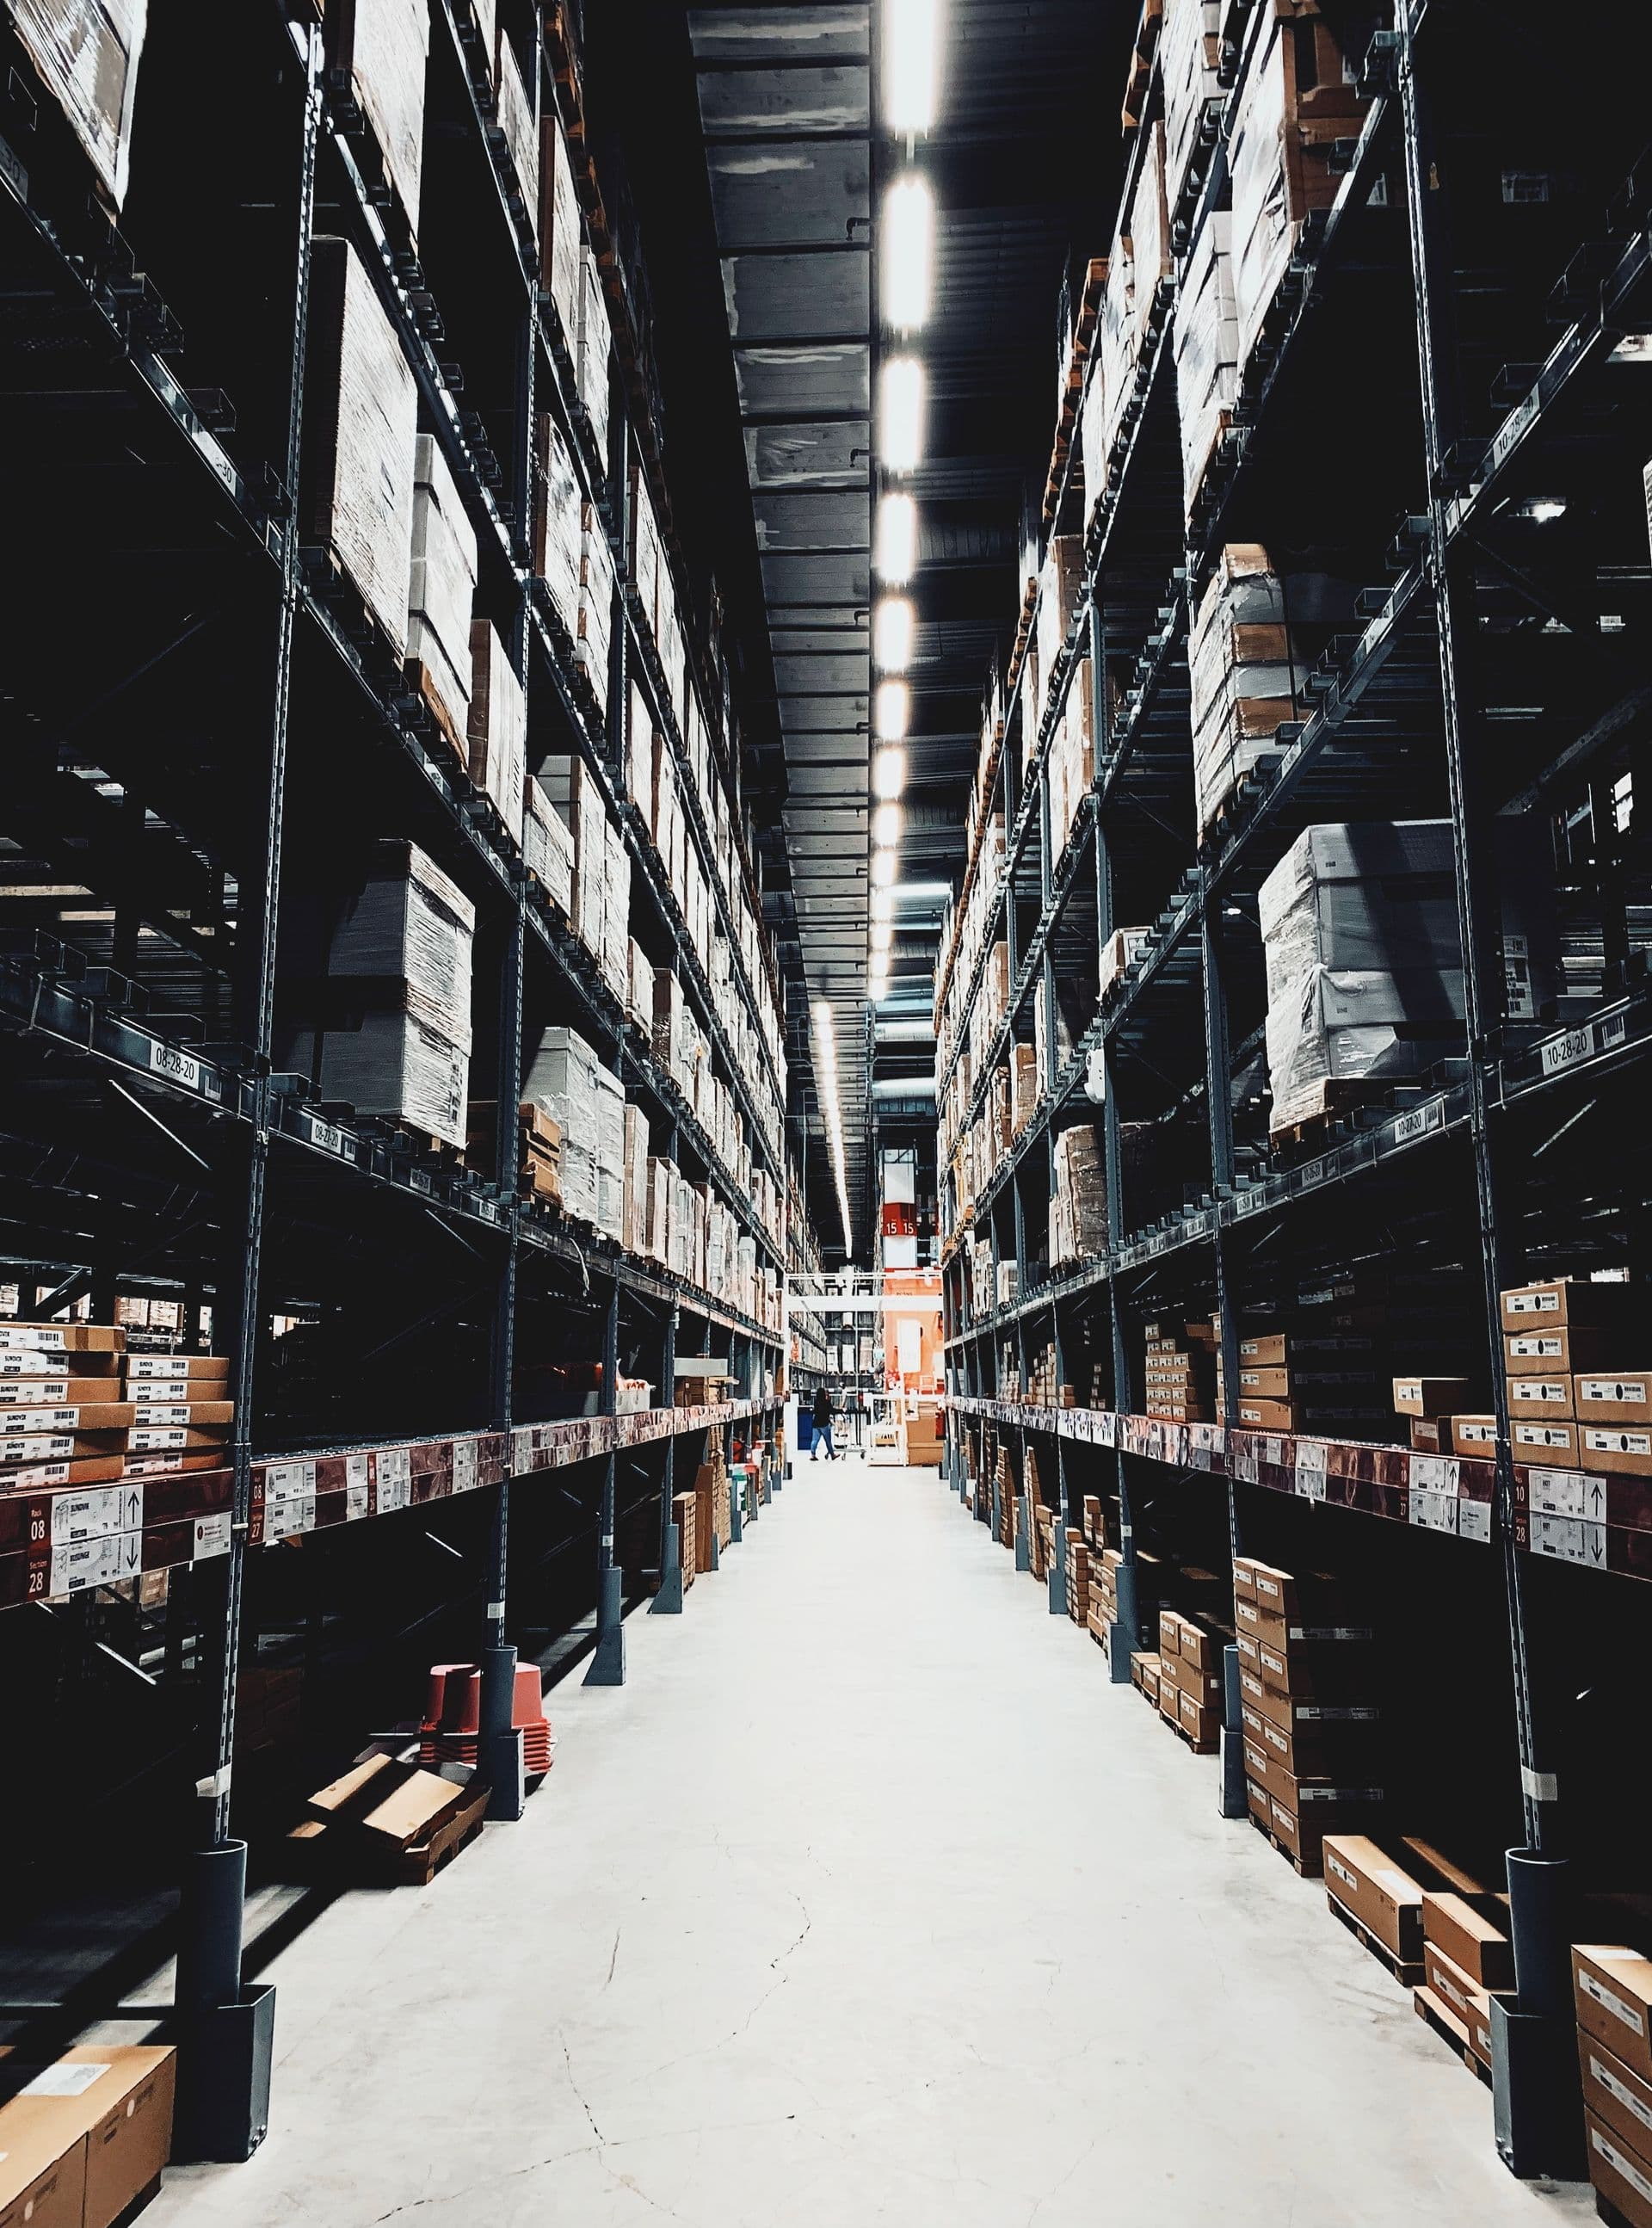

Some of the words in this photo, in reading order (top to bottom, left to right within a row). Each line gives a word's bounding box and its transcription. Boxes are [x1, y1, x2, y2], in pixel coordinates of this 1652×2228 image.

[1547, 1032, 1587, 1066] 10-28-20
[156, 1047, 194, 1081] 08-28-20
[1397, 1113, 1421, 1137] 10-27-20
[315, 1124, 339, 1148] 08-27-20
[886, 1222, 897, 1235] 15
[903, 1222, 915, 1235] 15
[253, 1484, 262, 1499] 08
[1516, 1486, 1525, 1502] 10
[31, 1519, 46, 1541] 08
[251, 1522, 261, 1539] 27
[1516, 1526, 1526, 1543] 28
[28, 1571, 44, 1594] 28
